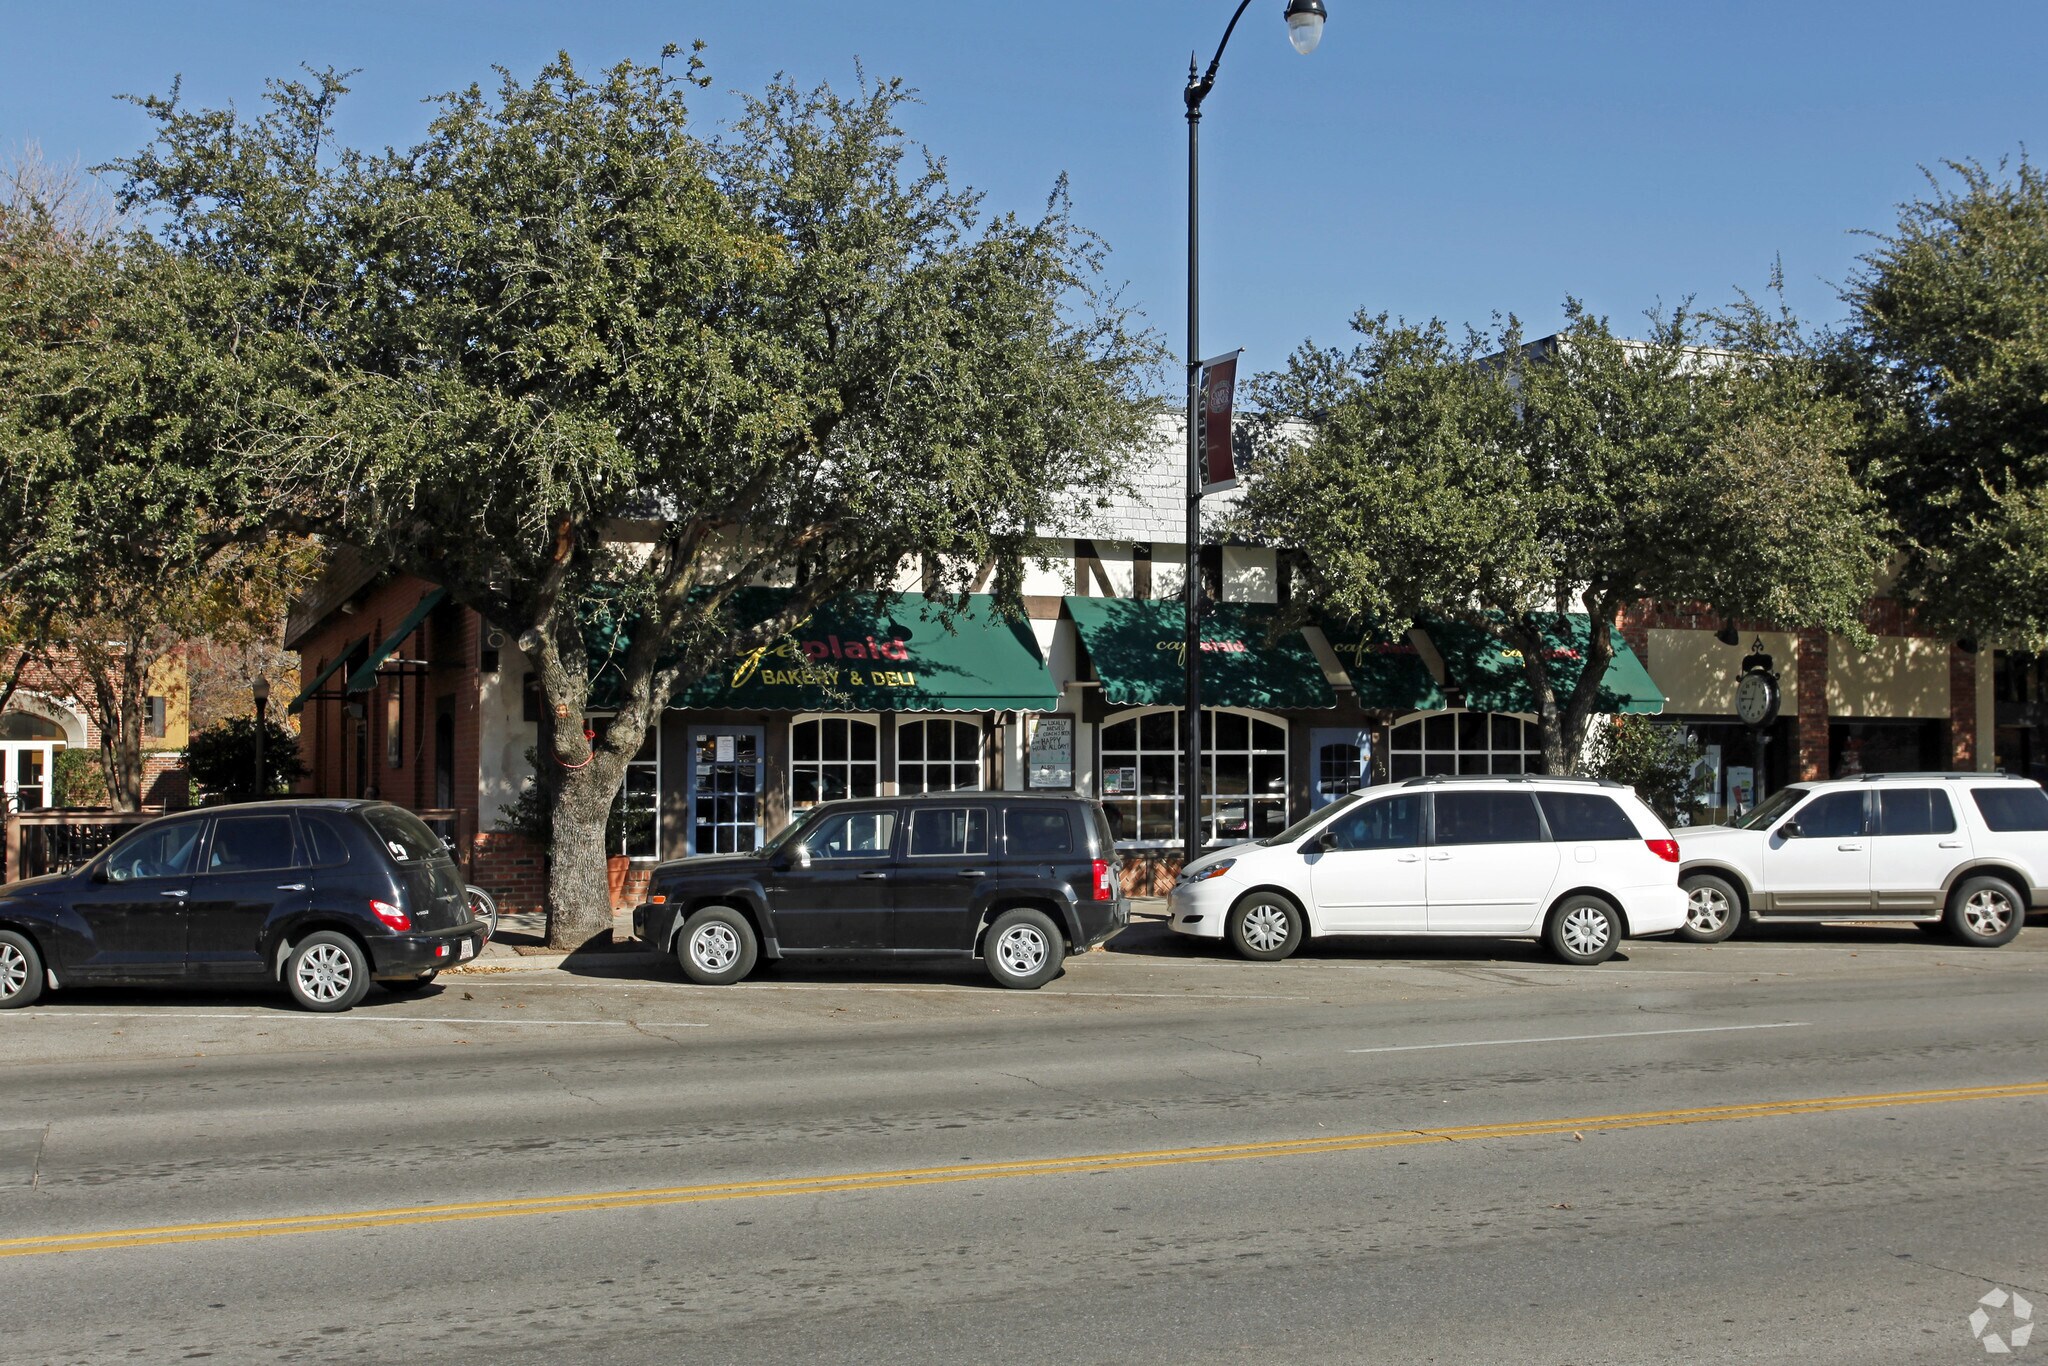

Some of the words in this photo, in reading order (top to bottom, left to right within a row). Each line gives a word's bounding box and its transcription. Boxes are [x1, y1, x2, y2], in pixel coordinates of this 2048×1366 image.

[802, 635, 908, 662] plaid
[761, 669, 839, 685] BAKERY
[850, 670, 864, 686] &
[870, 671, 915, 687] DELI
[1041, 736, 1062, 746] HAPPY
